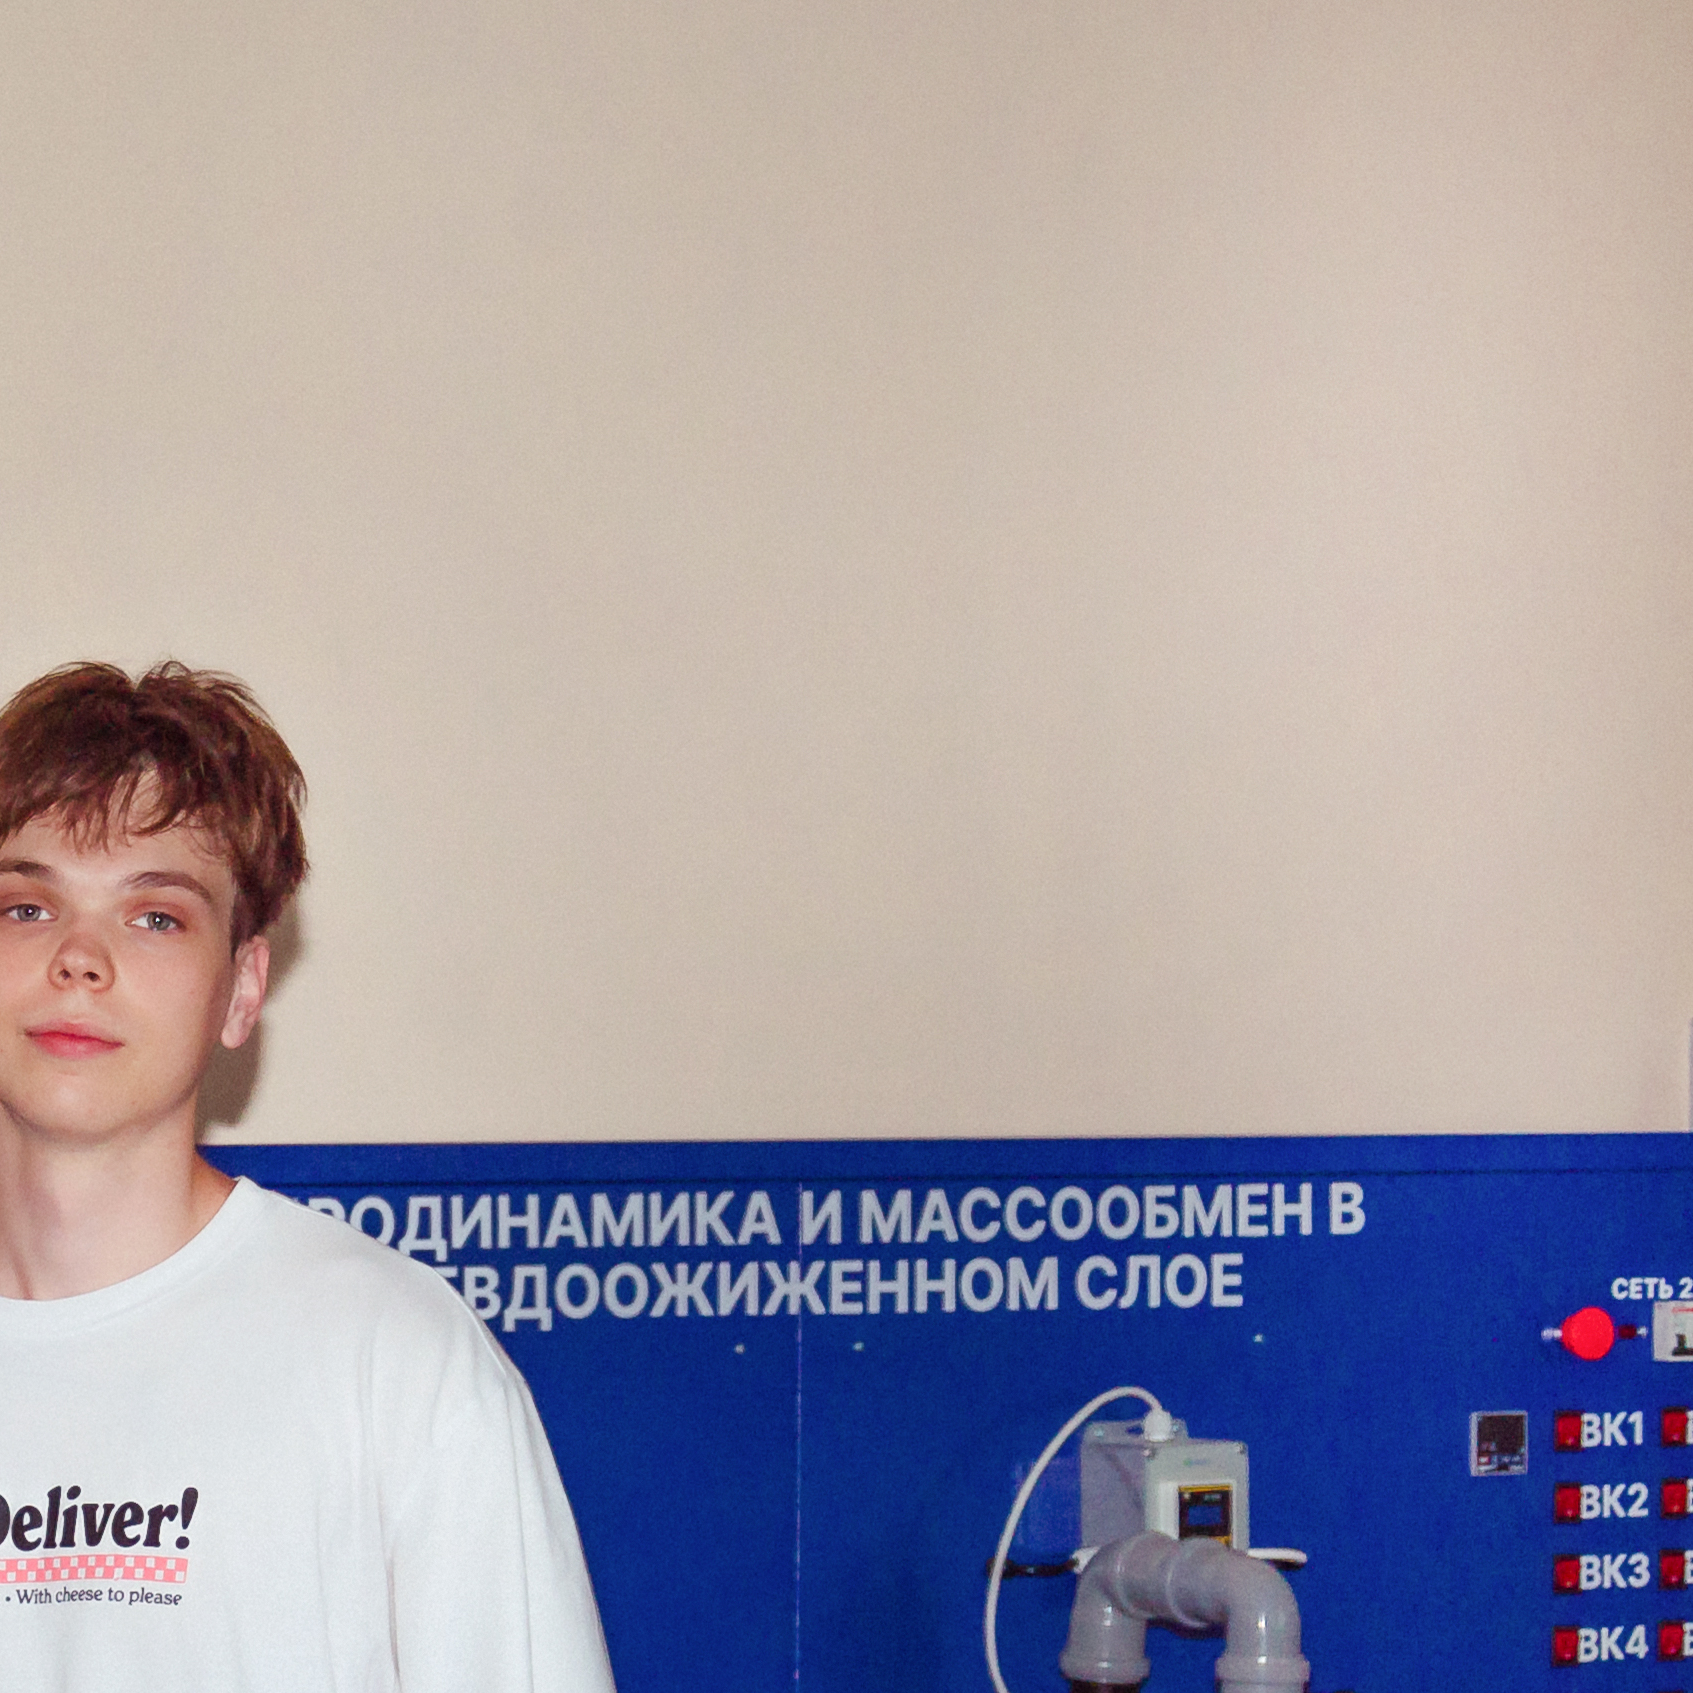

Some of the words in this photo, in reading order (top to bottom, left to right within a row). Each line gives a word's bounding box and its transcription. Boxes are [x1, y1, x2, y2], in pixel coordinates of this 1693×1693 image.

[308, 1188, 782, 1262] ОДИНАМИКА
[801, 1190, 841, 1244] И
[860, 1183, 1313, 1244] МАССООБМЕН
[1329, 1182, 1366, 1235] В
[433, 1254, 1059, 1332] ВДООЖИЖЕННОМ
[1076, 1253, 1244, 1310] СЛОЕ
[1611, 1277, 1674, 1300] СЕТЬ
[1581, 1411, 1644, 1448] ВК1
[1580, 1482, 1649, 1520] ВК2
[1579, 1552, 1650, 1590] ВК3
[15, 1588, 52, 1605] With
[55, 1586, 104, 1603] cheese
[107, 1587, 125, 1602] to
[128, 1588, 183, 1606] please
[1577, 1624, 1649, 1663] ВК4
